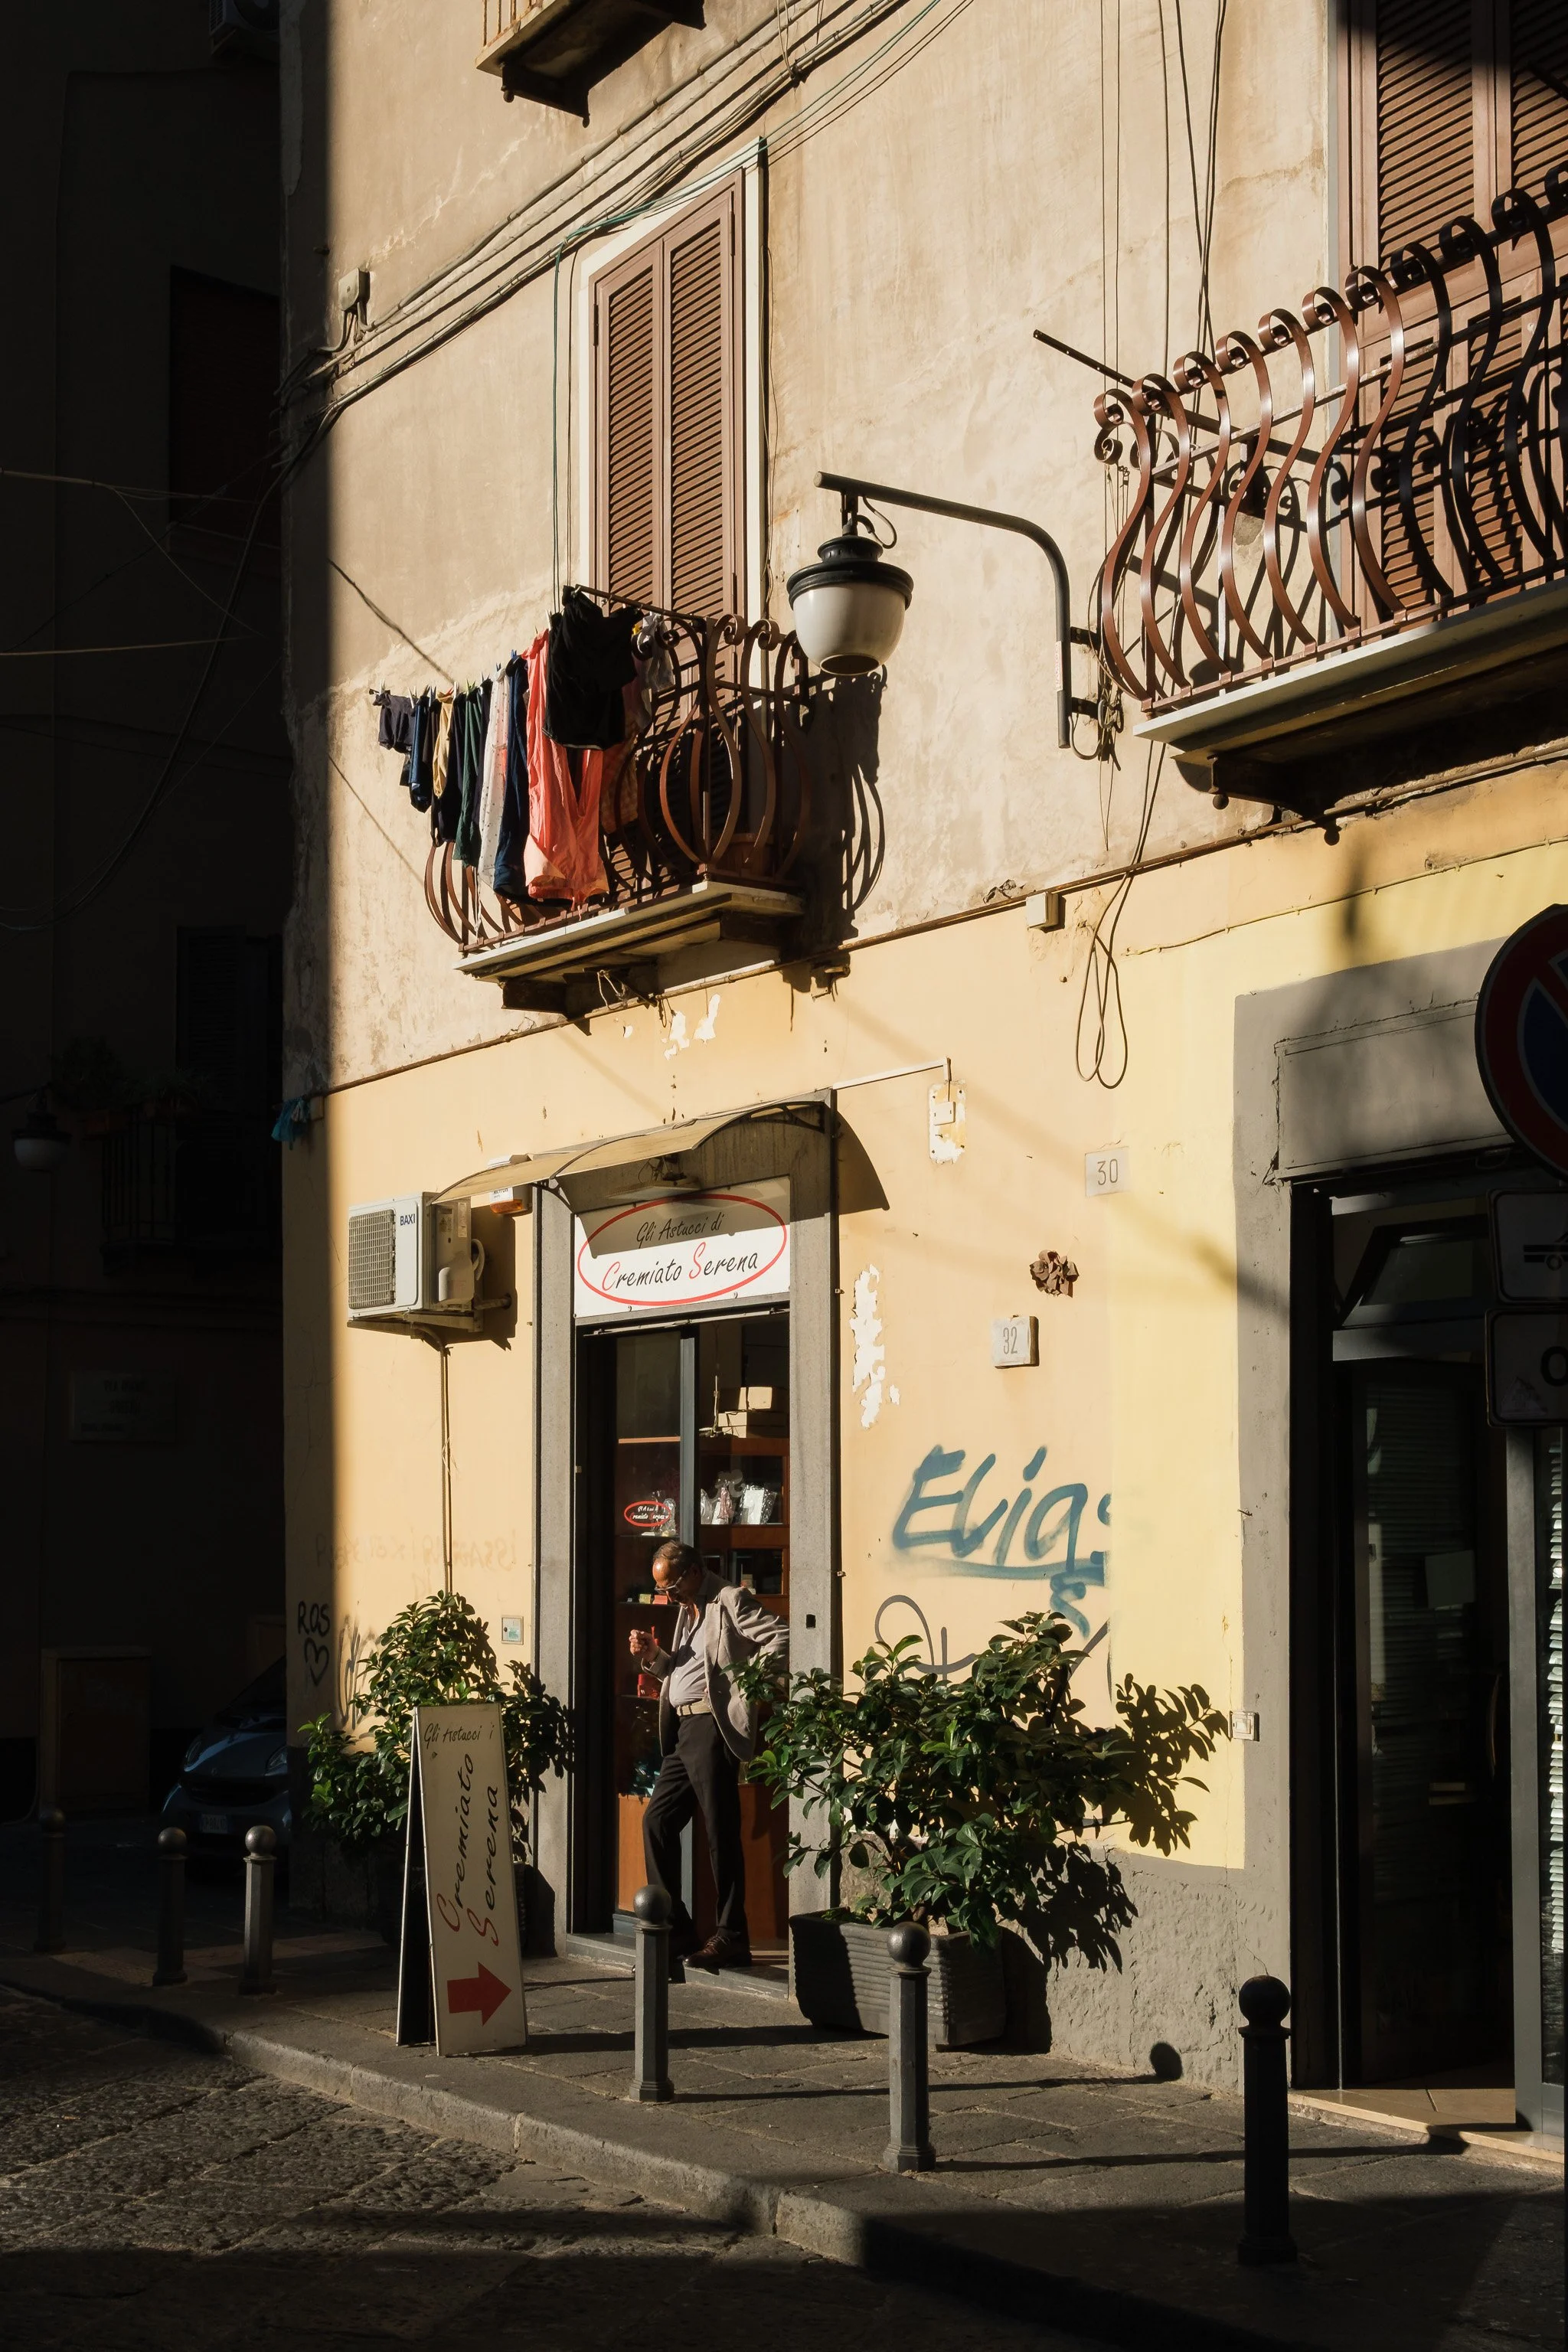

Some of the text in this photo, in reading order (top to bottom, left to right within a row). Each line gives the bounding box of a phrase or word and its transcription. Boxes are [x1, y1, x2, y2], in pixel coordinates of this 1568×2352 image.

[1096, 1158, 1119, 1186] 30
[400, 1214, 416, 1227] BAXI
[635, 1211, 725, 1249] Gli Astucci di
[602, 1242, 759, 1291] Cremiato Serena
[1002, 1326, 1018, 1356] 32
[423, 1723, 441, 1749] Gli
[443, 1725, 482, 1743] Astucci
[436, 1753, 474, 1933] Cremiato
[467, 1785, 499, 1948] Serena
